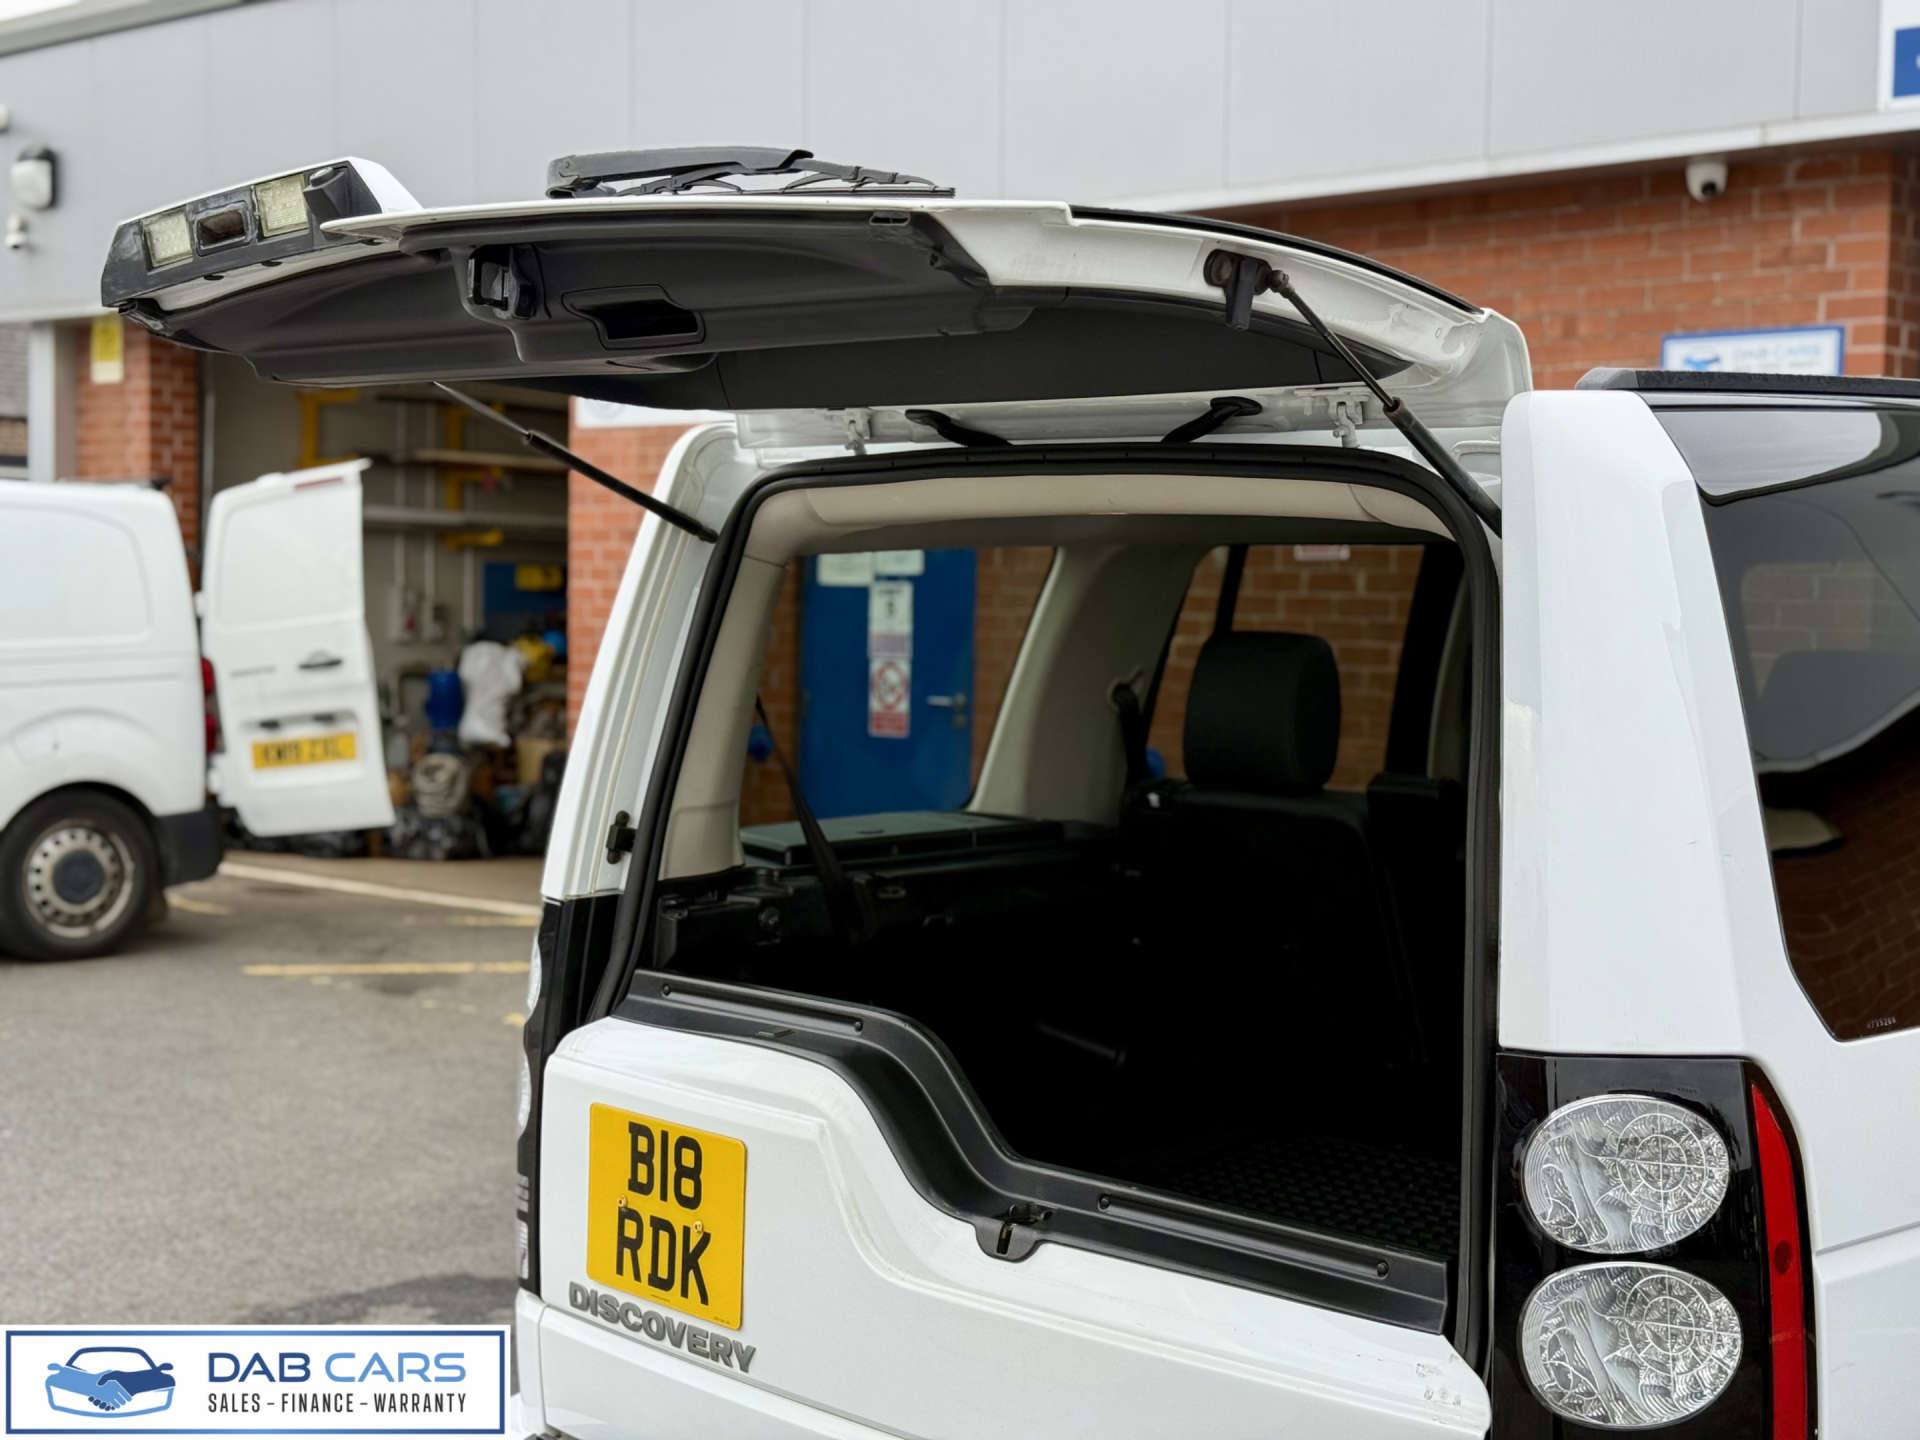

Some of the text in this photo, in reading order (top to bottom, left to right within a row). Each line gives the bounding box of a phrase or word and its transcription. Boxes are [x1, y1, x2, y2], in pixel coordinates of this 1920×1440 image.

[627, 1121, 702, 1210] B18
[616, 1206, 711, 1306] RDK
[568, 1281, 756, 1373] DISCOVERY
